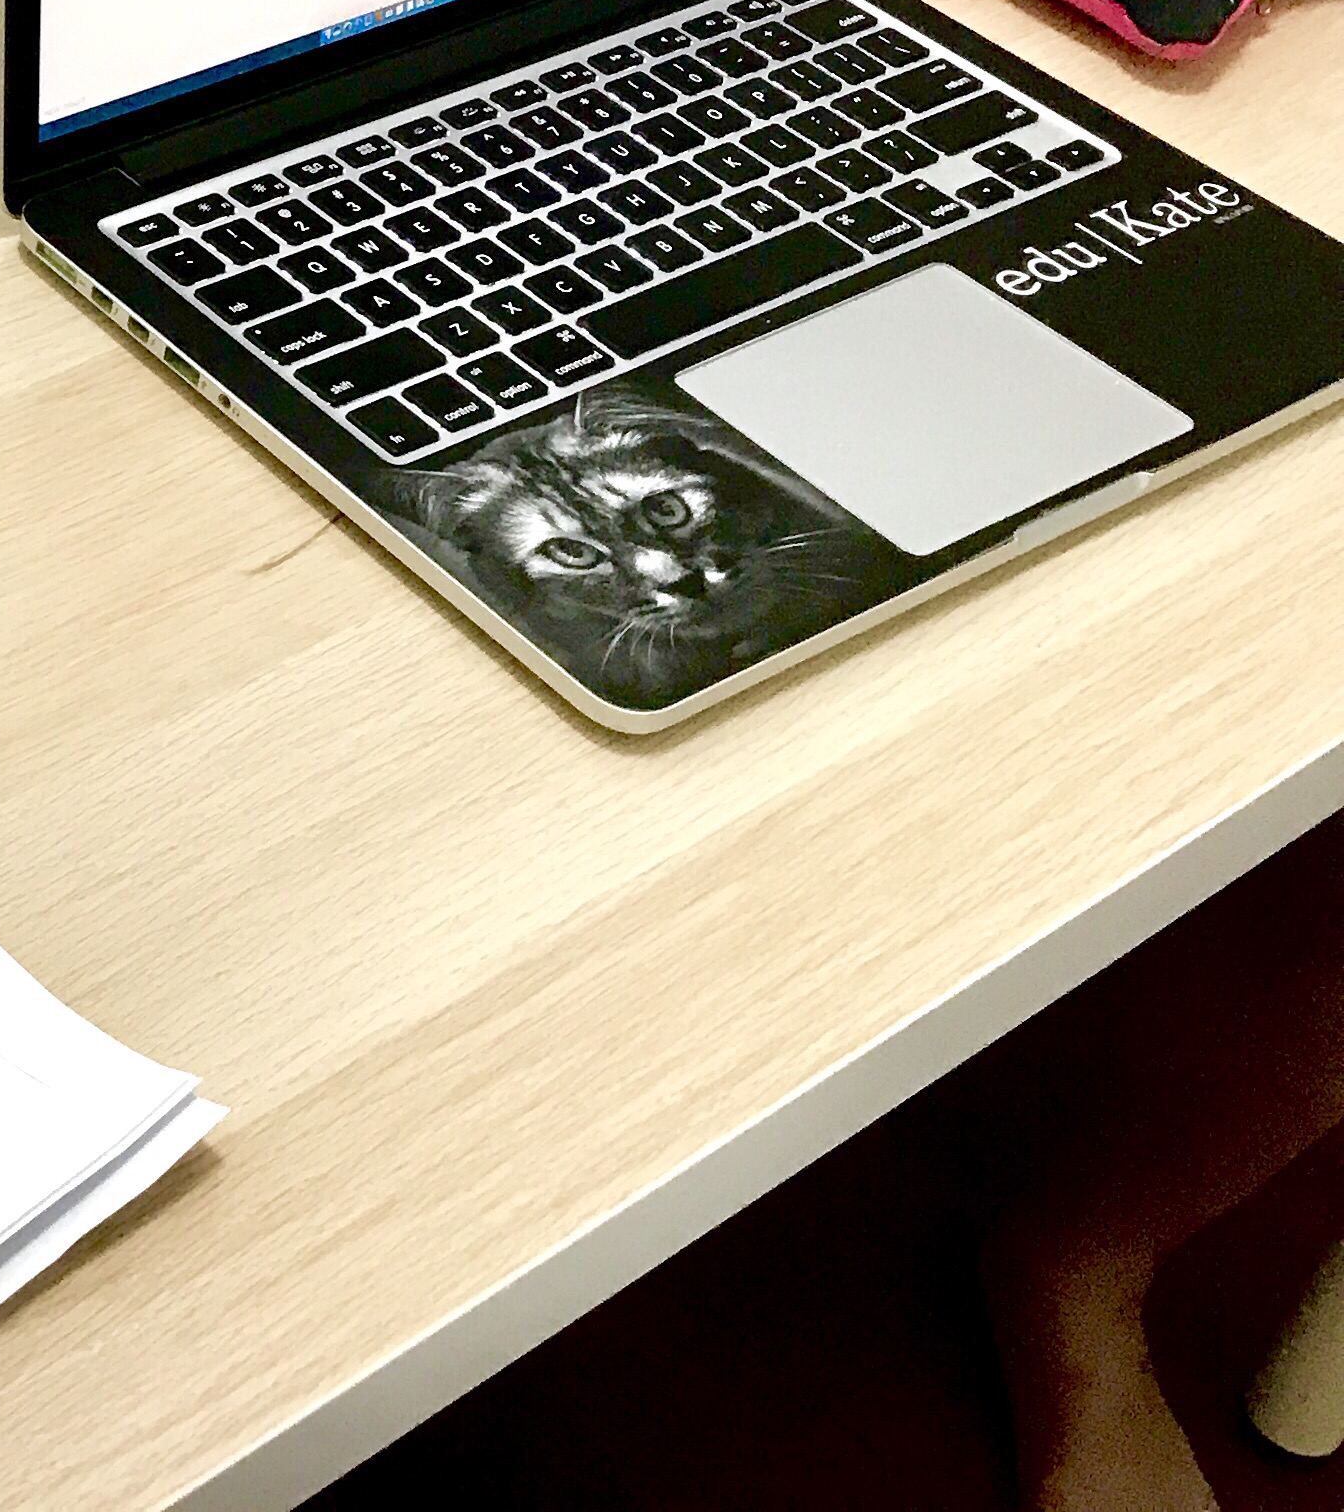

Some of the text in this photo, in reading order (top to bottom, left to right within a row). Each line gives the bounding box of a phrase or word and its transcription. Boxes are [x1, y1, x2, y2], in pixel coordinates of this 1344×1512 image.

[838, 11, 869, 31] delete
[930, 202, 960, 219] option
[867, 221, 912, 245] command
[228, 301, 249, 314] tab
[280, 330, 327, 355] caps lock
[555, 351, 603, 376] command
[329, 379, 355, 395] shift
[499, 380, 532, 400] option
[443, 402, 479, 422] control
[389, 433, 405, 445] fn
